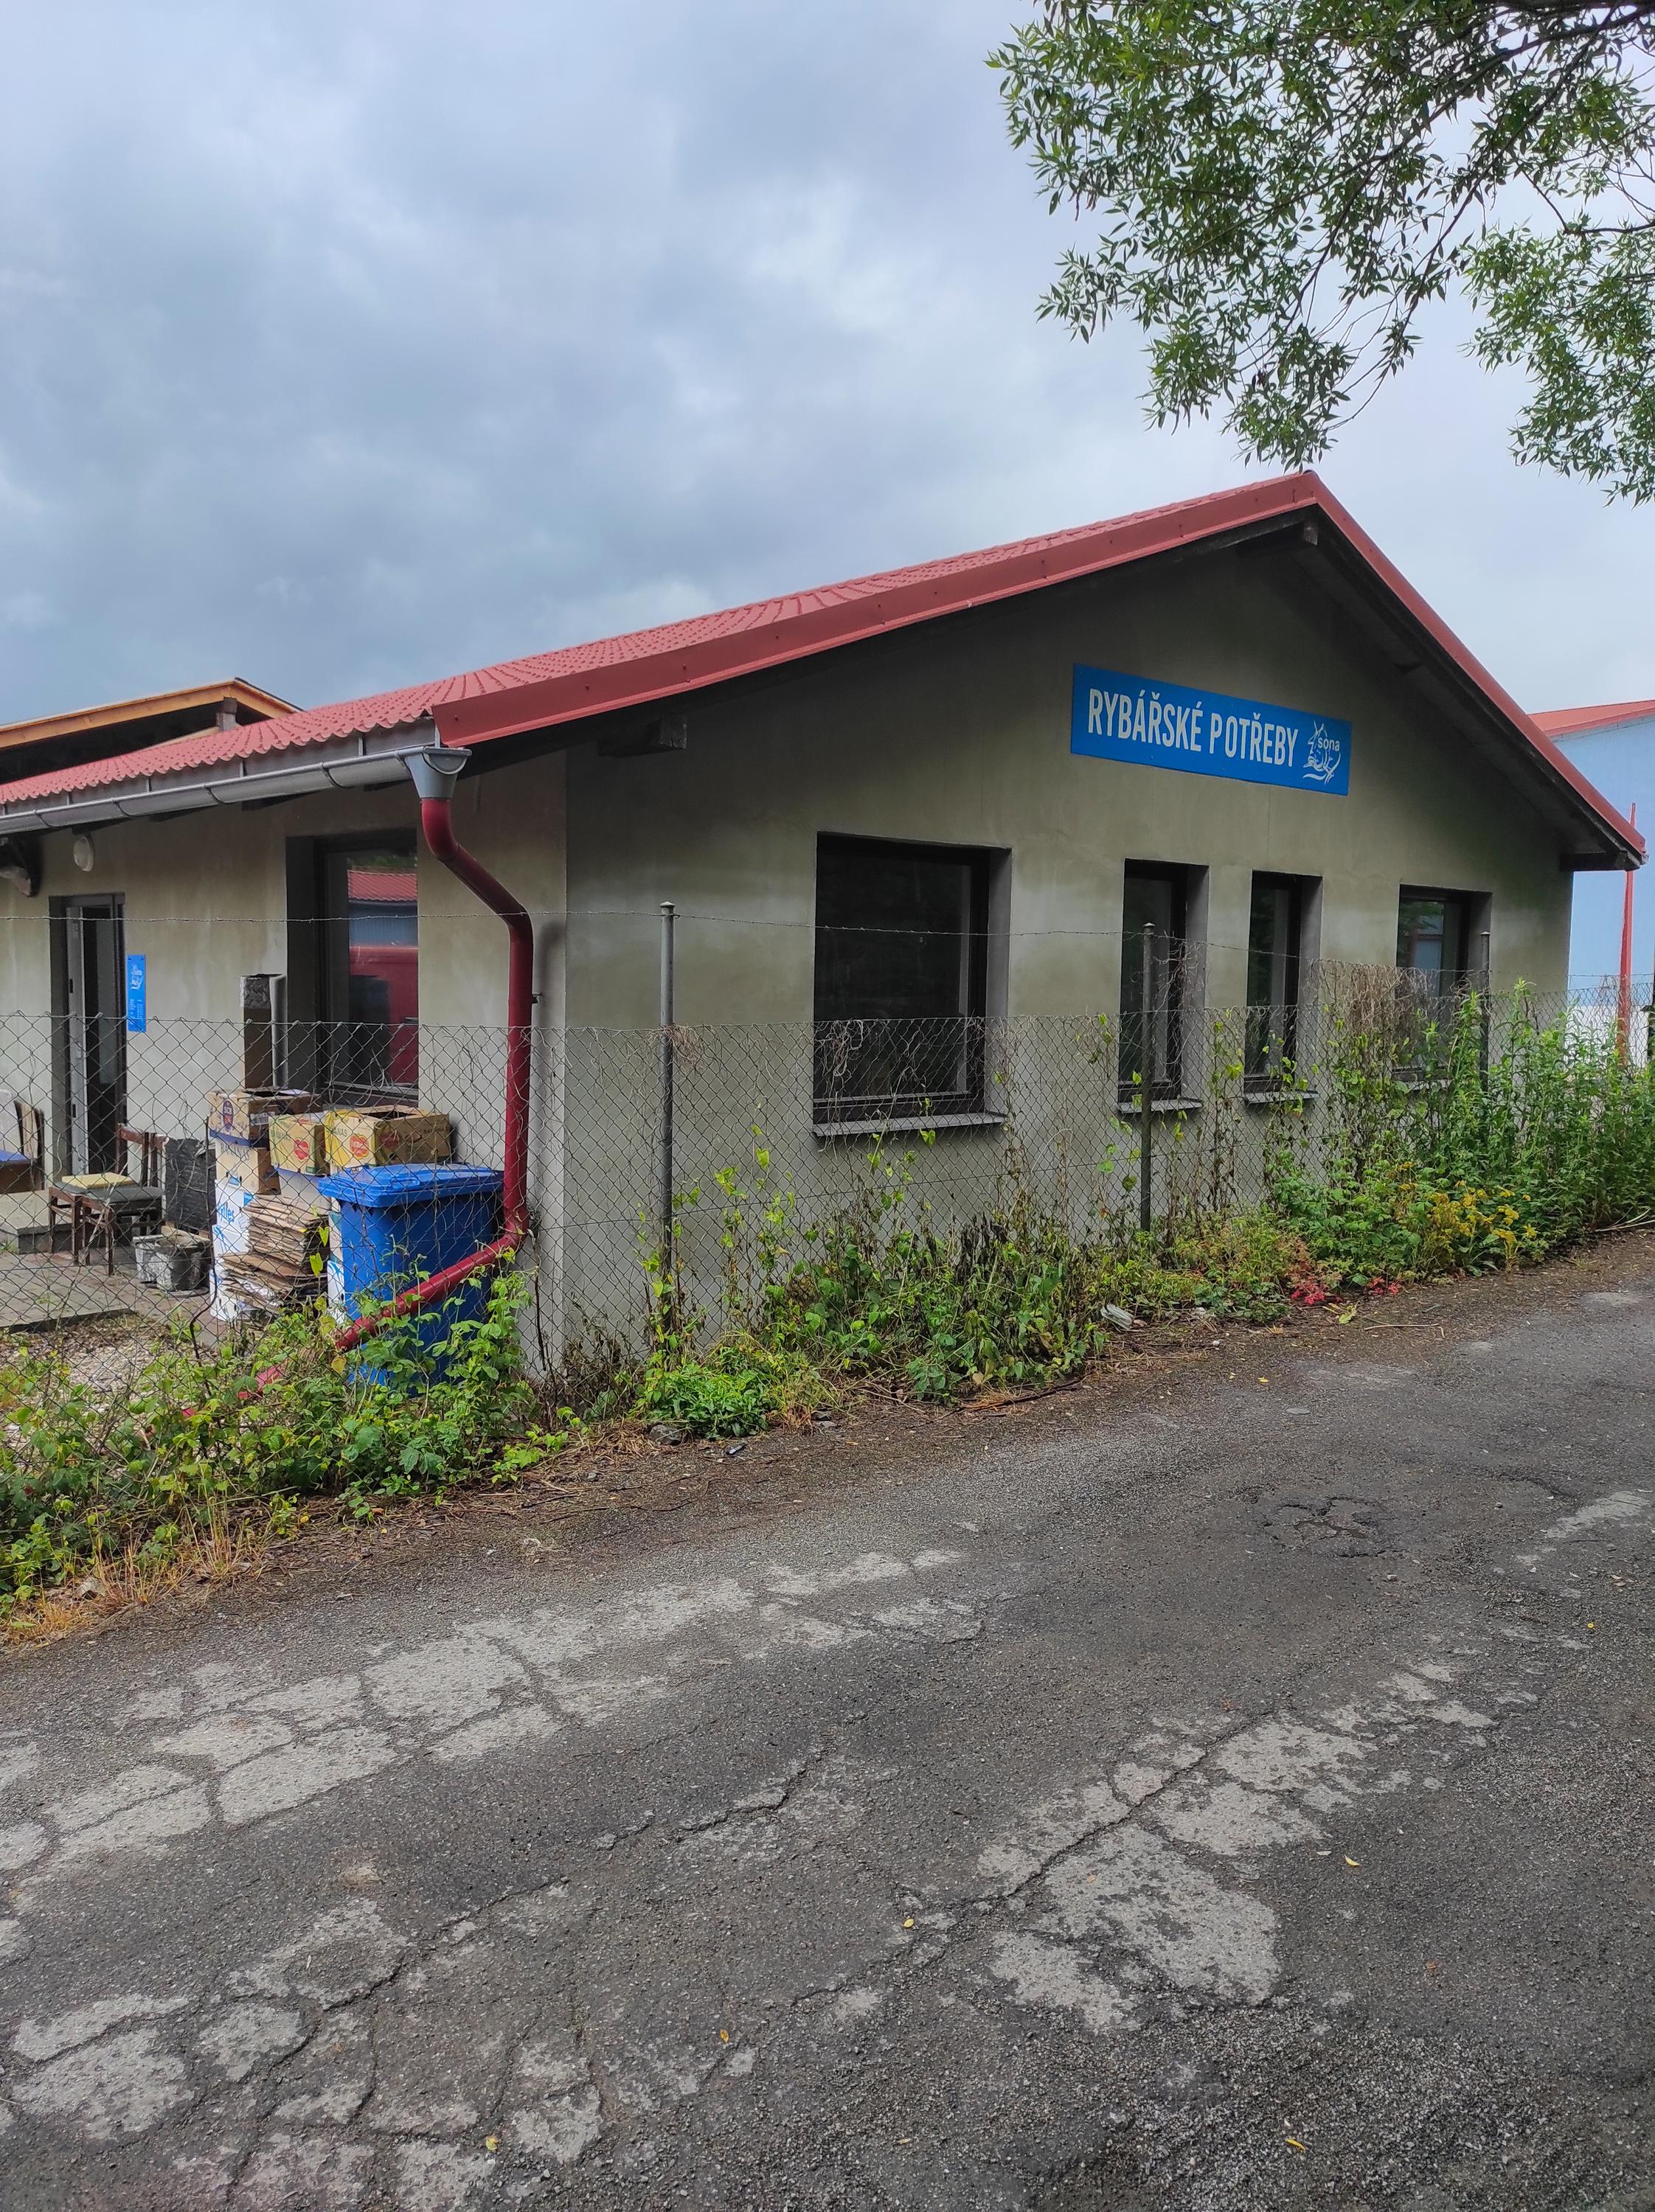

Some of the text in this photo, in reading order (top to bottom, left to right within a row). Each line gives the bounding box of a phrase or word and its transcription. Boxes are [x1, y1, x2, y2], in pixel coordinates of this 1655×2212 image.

[1088, 688, 1299, 768] RYBÁŘSKÉ POTŘEBY
[1317, 737, 1340, 752] sona
